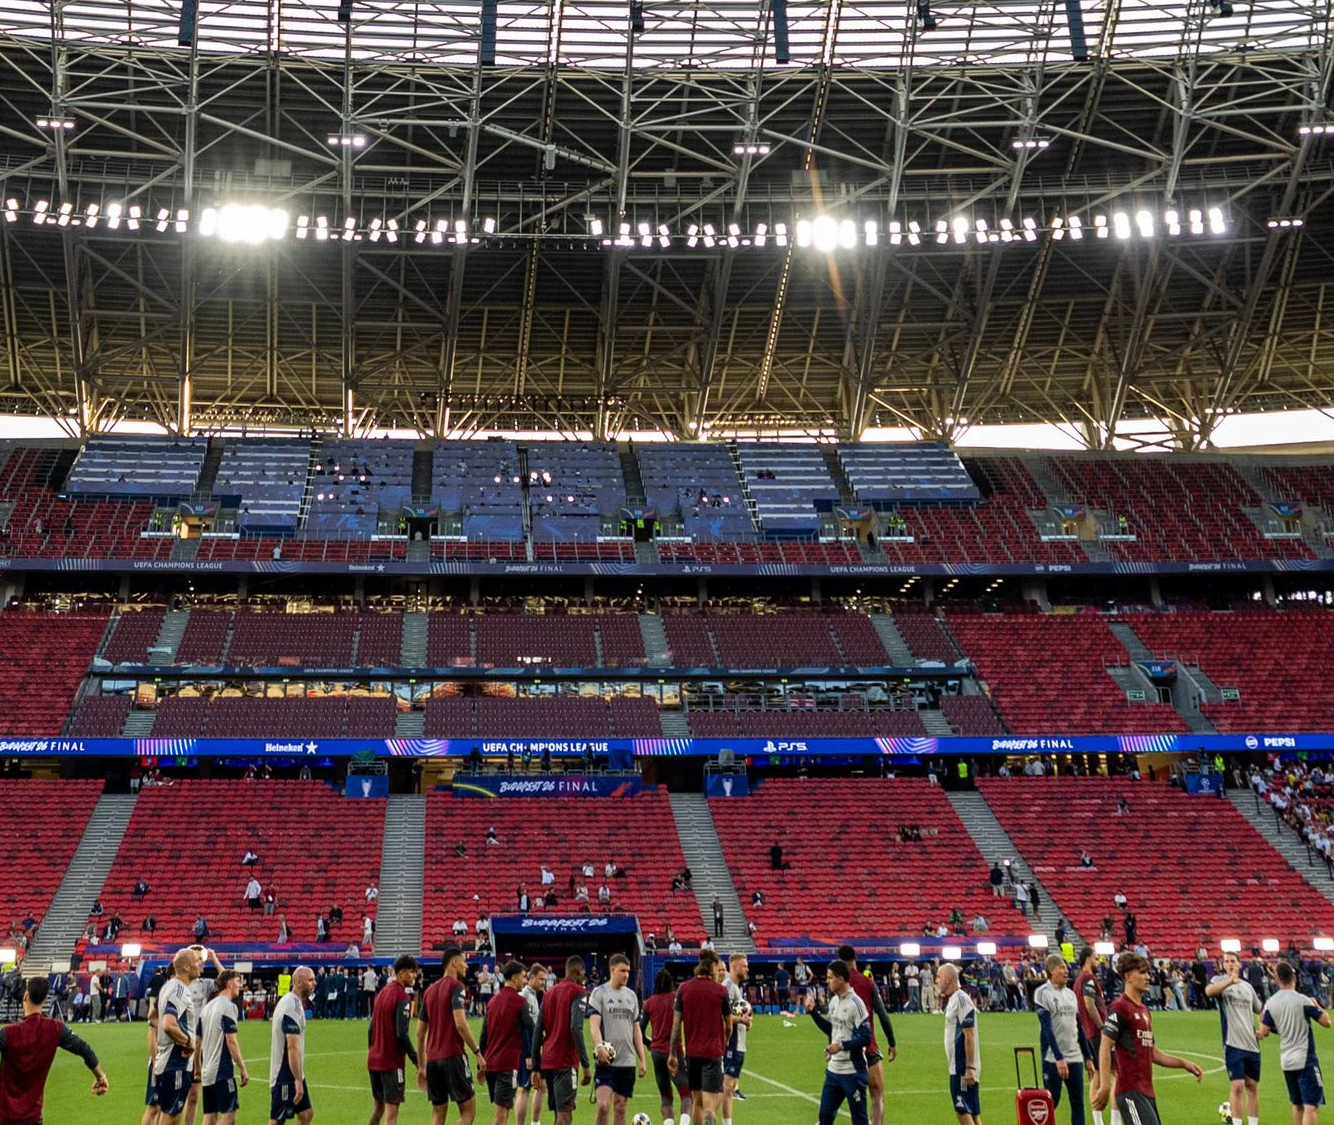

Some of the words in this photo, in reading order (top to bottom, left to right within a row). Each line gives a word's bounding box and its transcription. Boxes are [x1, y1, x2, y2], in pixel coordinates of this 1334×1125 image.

[50, 741, 85, 751] FINAL
[265, 742, 304, 752] Heineken
[482, 743, 508, 752] UEFA
[509, 742, 568, 752] CHMPONS
[779, 742, 806, 751] PS5
[1041, 739, 1074, 748] FINAL
[1264, 737, 1296, 747] PEPSI
[500, 781, 542, 793] BUDAPEST
[558, 781, 598, 791] FINAL
[521, 918, 589, 928] BUDAPEST
